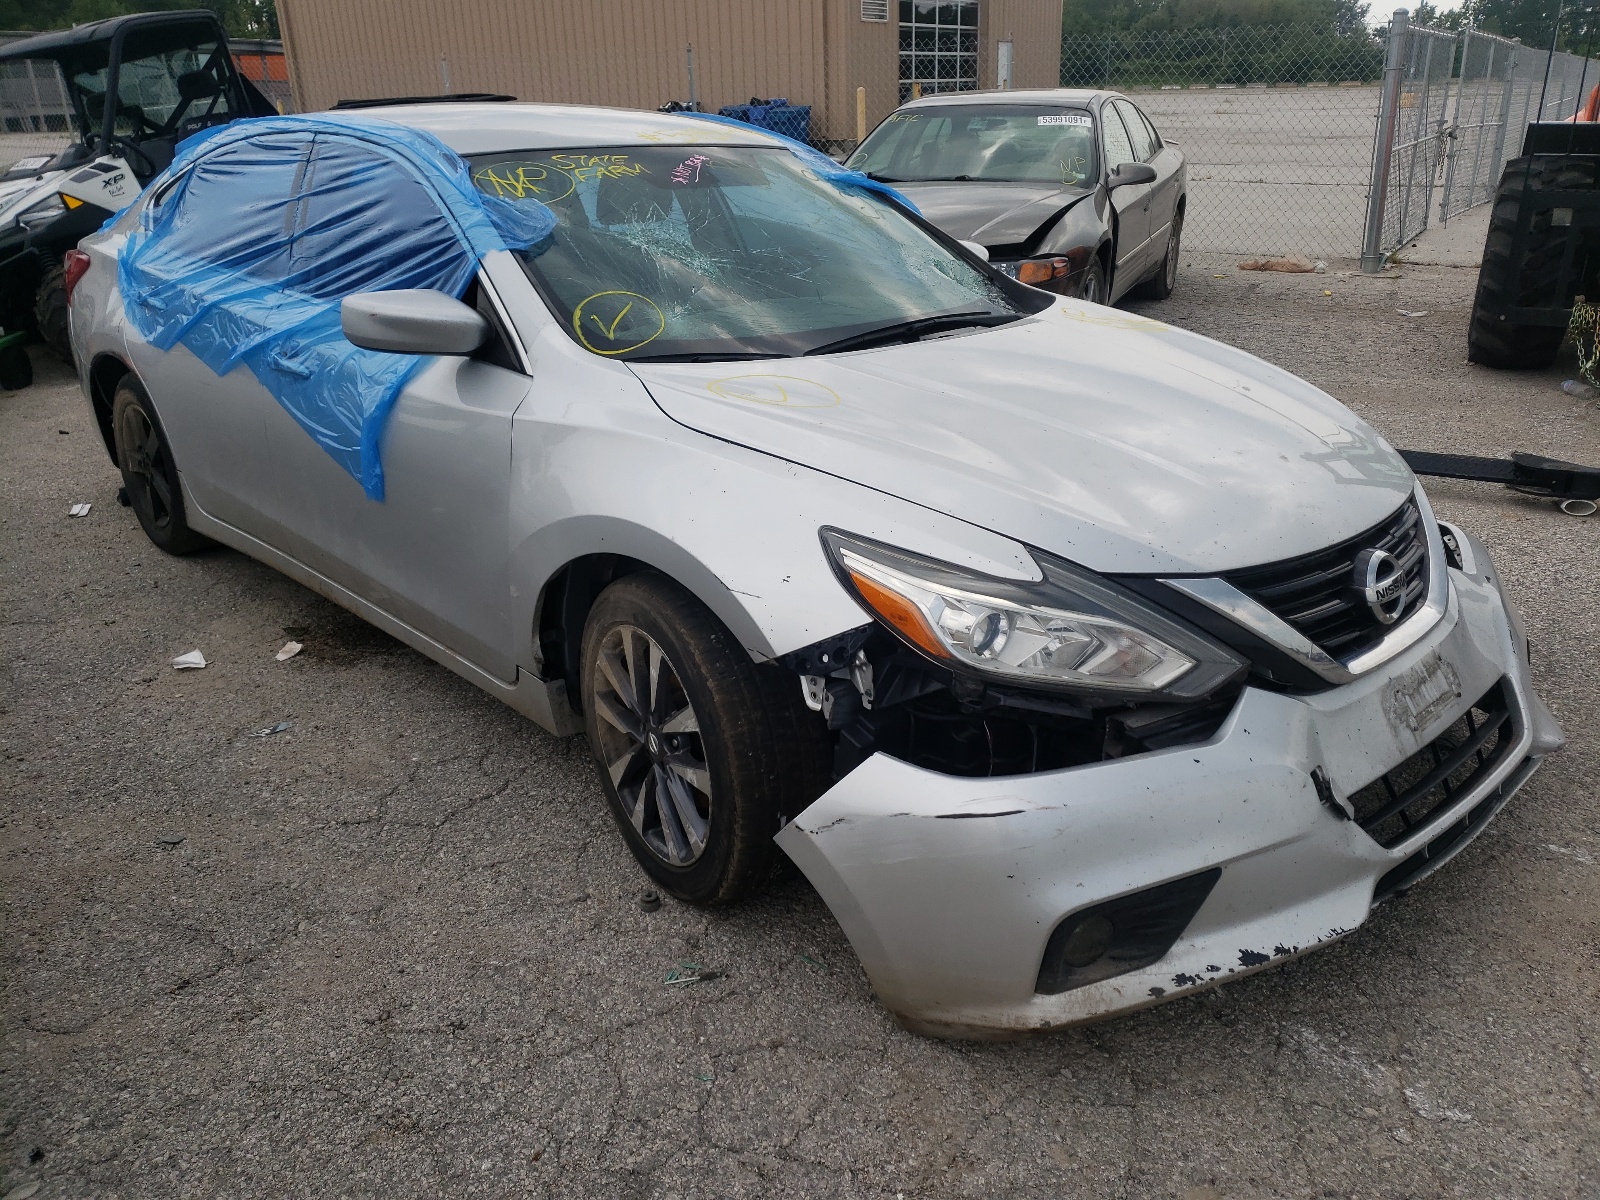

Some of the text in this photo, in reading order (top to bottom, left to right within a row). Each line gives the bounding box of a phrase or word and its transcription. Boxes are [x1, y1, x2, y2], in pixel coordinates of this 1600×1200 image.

[550, 153, 630, 170] STATE
[1059, 155, 1086, 172] NP
[574, 162, 653, 183] FARM
[101, 173, 126, 190] XP
